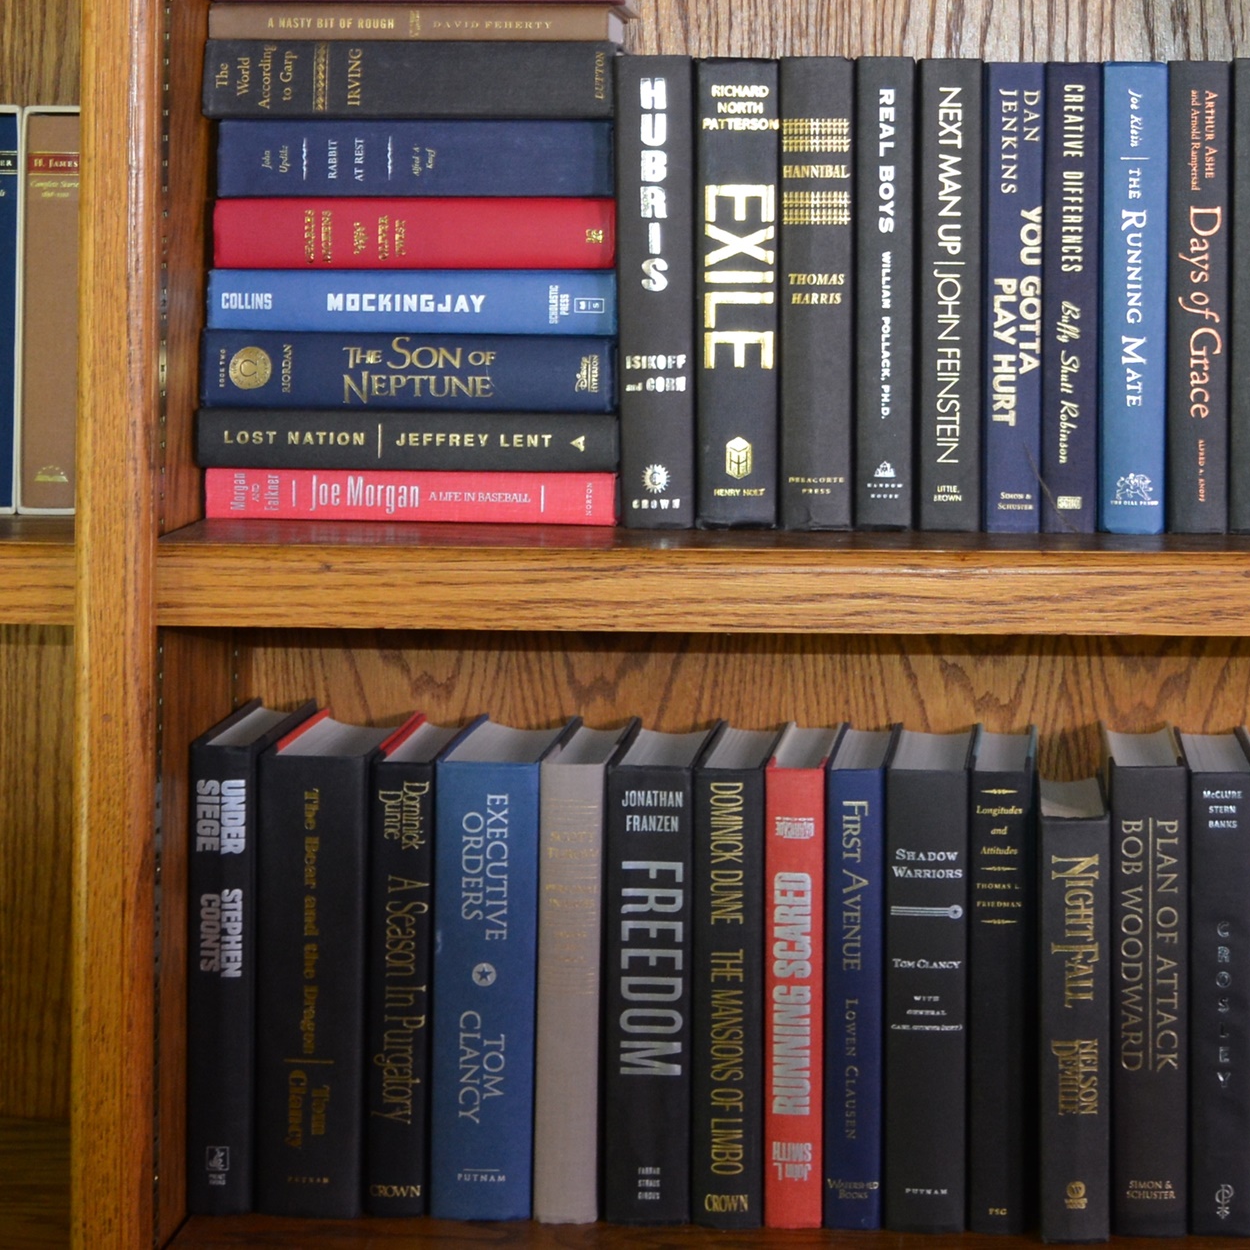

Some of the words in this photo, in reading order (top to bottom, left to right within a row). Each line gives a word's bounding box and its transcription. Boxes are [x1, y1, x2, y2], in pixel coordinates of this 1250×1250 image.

[878, 88, 895, 157] REAL
[940, 87, 962, 150] NEXT
[999, 89, 1017, 194] JENKINS
[1023, 91, 1039, 142] DAN
[1063, 84, 1085, 158] CREATIVE
[640, 78, 669, 292] HUBRIS
[783, 164, 850, 178] HANNIBAL
[878, 166, 894, 234] BOYS
[938, 152, 962, 217] MAN
[1129, 168, 1141, 199] THE
[937, 225, 961, 255] UP
[1061, 171, 1084, 273] DIFFERENCES
[1179, 206, 1222, 283] Days
[704, 184, 775, 369] EXILE
[1122, 209, 1147, 325] RUNNING
[221, 292, 272, 310] COLLINS
[327, 293, 486, 313] MOCKINGJAY
[934, 267, 961, 341] JOHN
[1178, 294, 1220, 323] of
[343, 347, 383, 369] THE
[387, 336, 462, 369] SON
[468, 351, 496, 366] OF
[1122, 336, 1146, 408] MATE
[1189, 328, 1222, 418] Grace
[343, 370, 495, 404] NEPTUNE
[937, 347, 960, 463] FEINSTEIN
[224, 430, 277, 444] LOST
[288, 430, 365, 445] NATION
[396, 432, 489, 446] JEFFREY
[500, 433, 552, 448] LENT
[310, 475, 340, 511] Joe
[347, 475, 419, 514] Morgan
[621, 790, 683, 808] JONATHAN
[626, 815, 679, 833] FRANZEN
[842, 799, 868, 863] FIRST
[461, 812, 483, 921] ORDERS
[484, 794, 509, 941] EXECUTIVE
[892, 866, 963, 880] WARRIORS
[895, 849, 958, 862] SHADOW
[1121, 820, 1143, 875] BOB
[1155, 819, 1178, 894] PLAN
[842, 870, 869, 971] AVENUE
[1156, 909, 1178, 946] OF
[619, 860, 683, 1076] FREEDOM
[710, 949, 744, 982] THE
[1121, 886, 1143, 1072] WOODWARD
[710, 990, 744, 1083] MANSIONS
[1156, 954, 1179, 1073] ATTACK
[458, 1011, 481, 1123] CLANCY
[483, 1034, 505, 1100] TOM
[711, 1089, 744, 1112] OF
[711, 1118, 744, 1176] LIMBO
